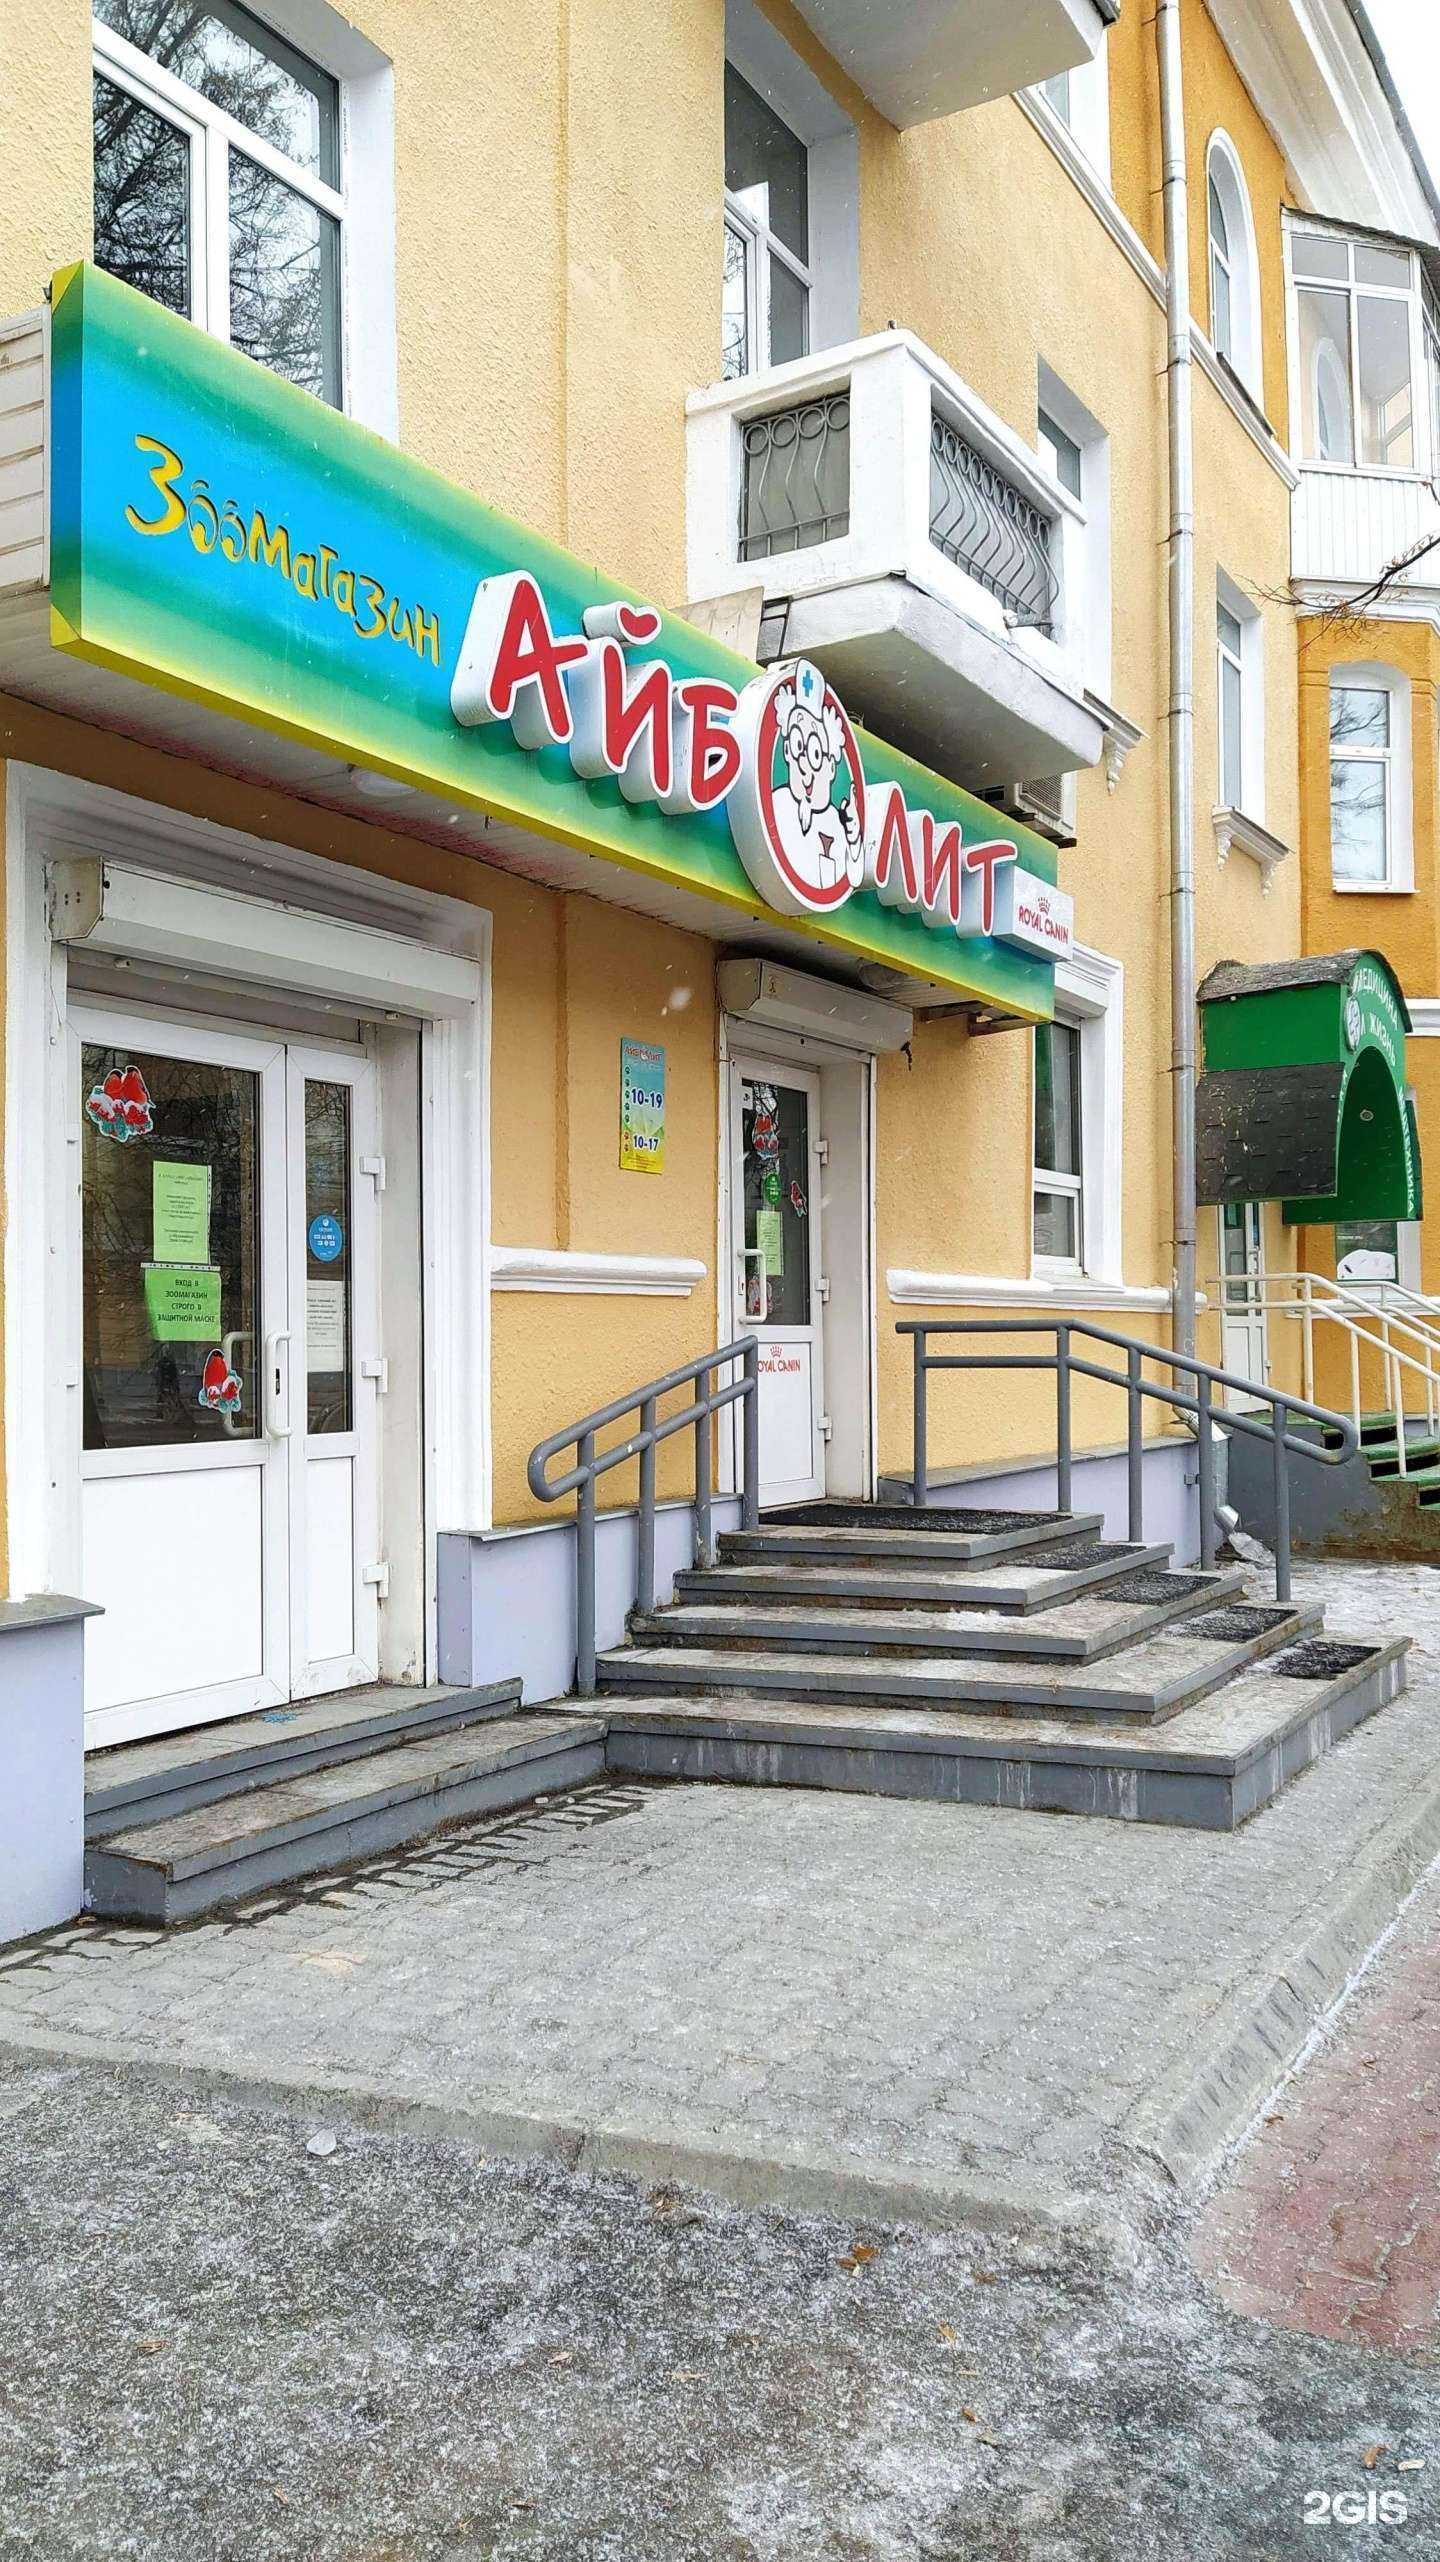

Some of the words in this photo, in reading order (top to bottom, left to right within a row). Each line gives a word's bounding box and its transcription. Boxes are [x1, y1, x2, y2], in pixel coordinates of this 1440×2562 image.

[1018, 904, 1043, 932] ROYAL
[1044, 918, 1069, 944] CANIN
[1369, 1011, 1396, 1067] ЖИЗНЬ
[631, 1088, 663, 1109] 10-19
[633, 1134, 659, 1152] 10-17
[165, 1290, 208, 1299] ЗООМАГАЗИН
[757, 1360, 776, 1373] OYAL
[778, 1360, 801, 1373] CANIN
